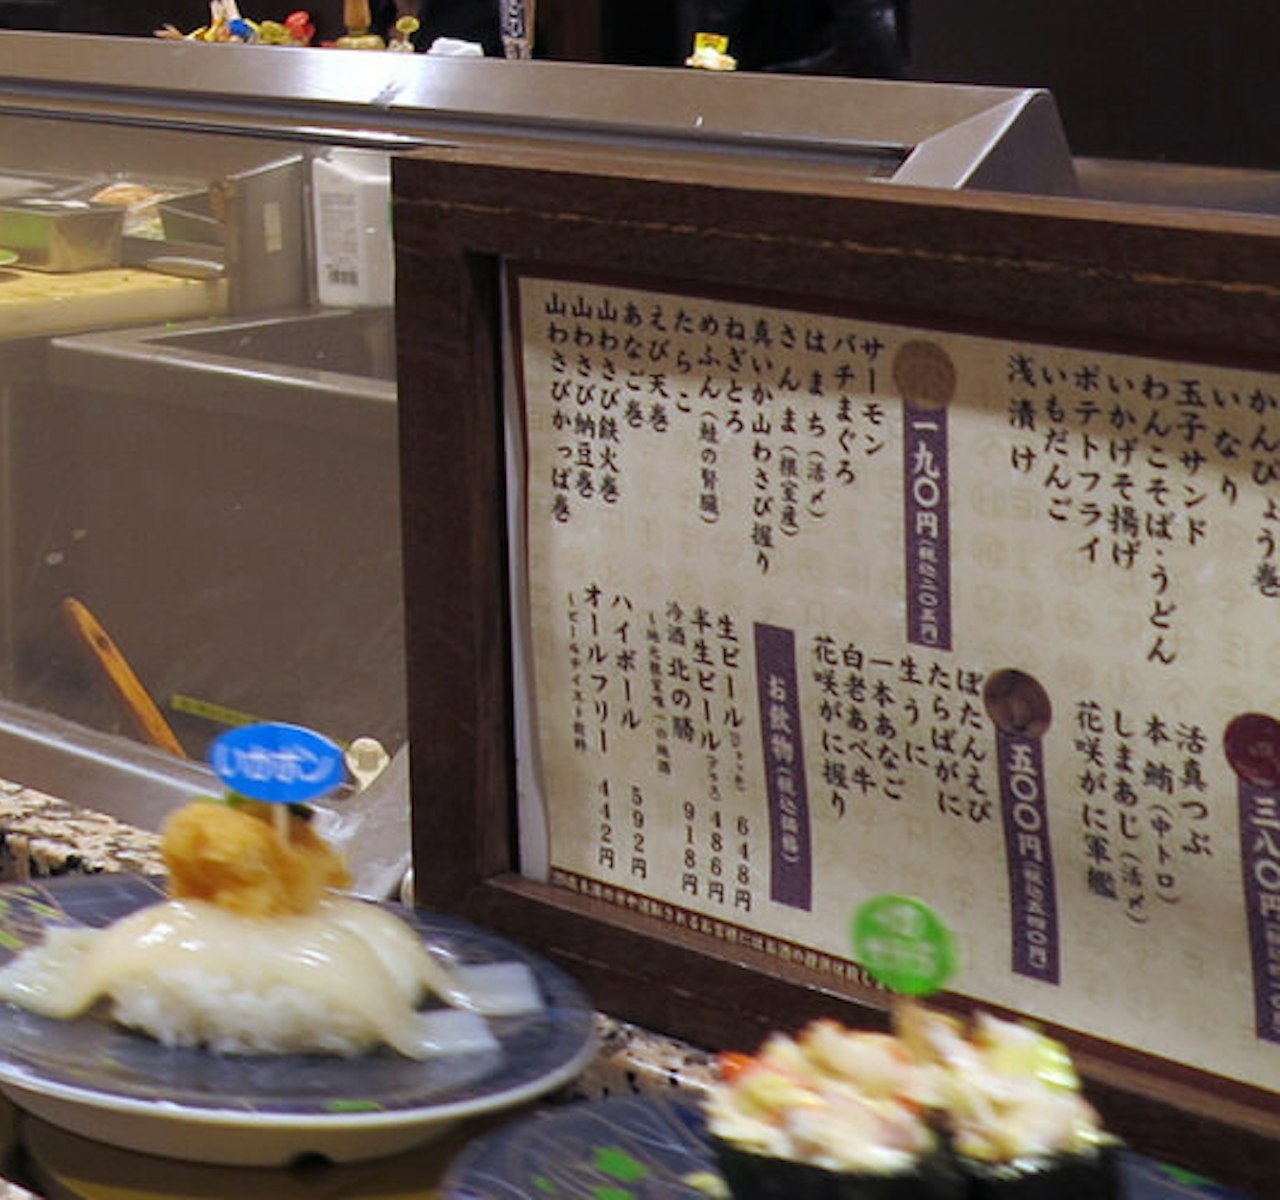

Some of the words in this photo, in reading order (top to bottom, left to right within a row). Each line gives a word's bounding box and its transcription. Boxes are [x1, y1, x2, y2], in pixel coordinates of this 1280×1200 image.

[545, 293, 572, 523] 山わさびかっぱ巻
[571, 296, 595, 498] 山わさび納豆巻
[598, 299, 621, 504] 山わさび鉄火巻
[624, 304, 644, 429] あなご巻
[648, 304, 670, 433] えび天巻
[673, 310, 694, 414] たらこ
[725, 317, 746, 433] ねぎとろ
[833, 333, 857, 486] バチまぐろ
[861, 337, 886, 457] サーモン
[1007, 354, 1039, 474] 浅漬け
[750, 321, 775, 575] 真いか山わさび握り
[1042, 365, 1071, 523] いもだんご
[1073, 365, 1104, 563] ポテトフライ
[1106, 374, 1140, 571] いかげそ揚げ
[1141, 374, 1178, 666] わんこそば・うどん
[1176, 378, 1207, 547] 玉子サンド
[1211, 388, 1241, 506] いなり
[584, 582, 610, 754] オールフリー
[610, 593, 641, 731] ハイボール
[812, 635, 849, 820] 花咲がに握り
[869, 658, 906, 802] 一本あなご
[898, 655, 929, 767] 生うに
[928, 661, 963, 819] たらばがに
[956, 667, 994, 824] ぼたんえび
[1074, 700, 1118, 901] 花咲がに軍艦
[682, 801, 699, 896] 918円
